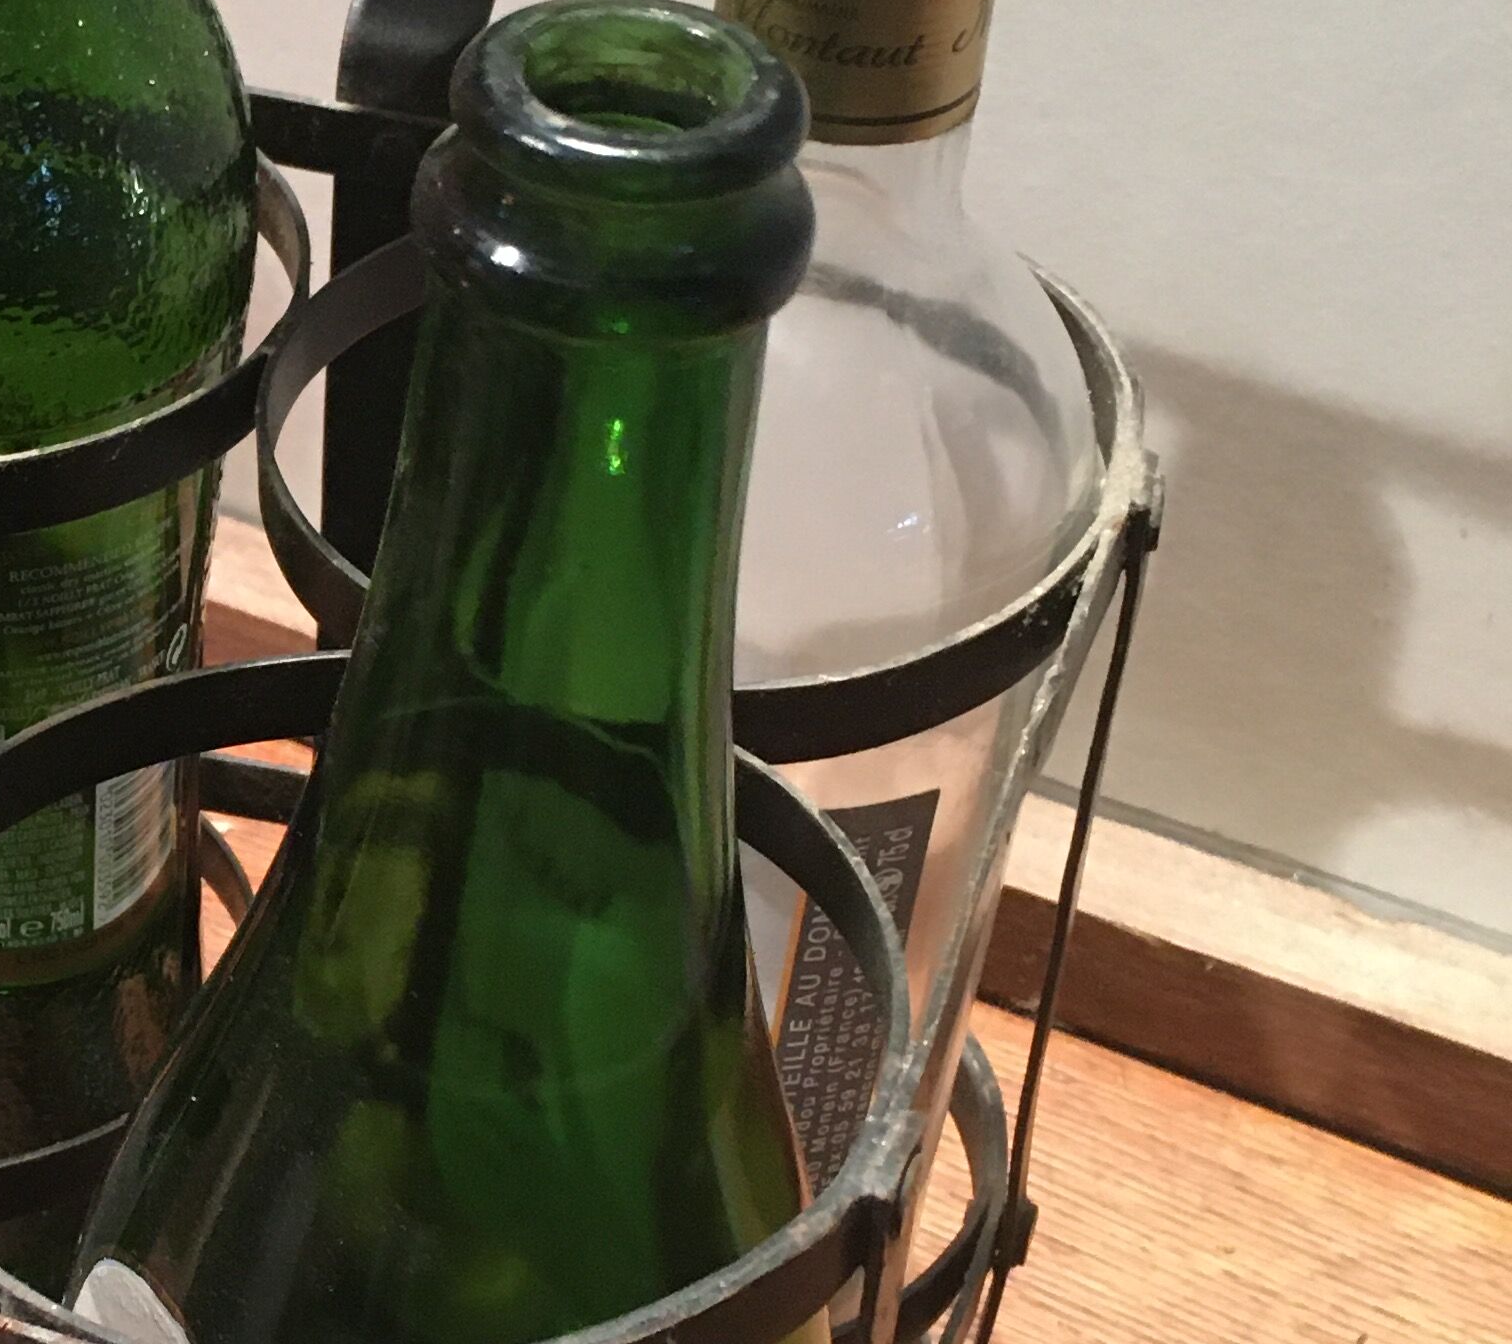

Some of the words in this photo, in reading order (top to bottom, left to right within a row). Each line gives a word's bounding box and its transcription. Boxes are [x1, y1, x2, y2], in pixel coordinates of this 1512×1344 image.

[794, 973, 821, 1007] AU
[801, 967, 844, 1089] Propriétaire
[851, 1023, 871, 1048] 38
[843, 1058, 864, 1081] 21
[809, 1081, 840, 1153] Monein
